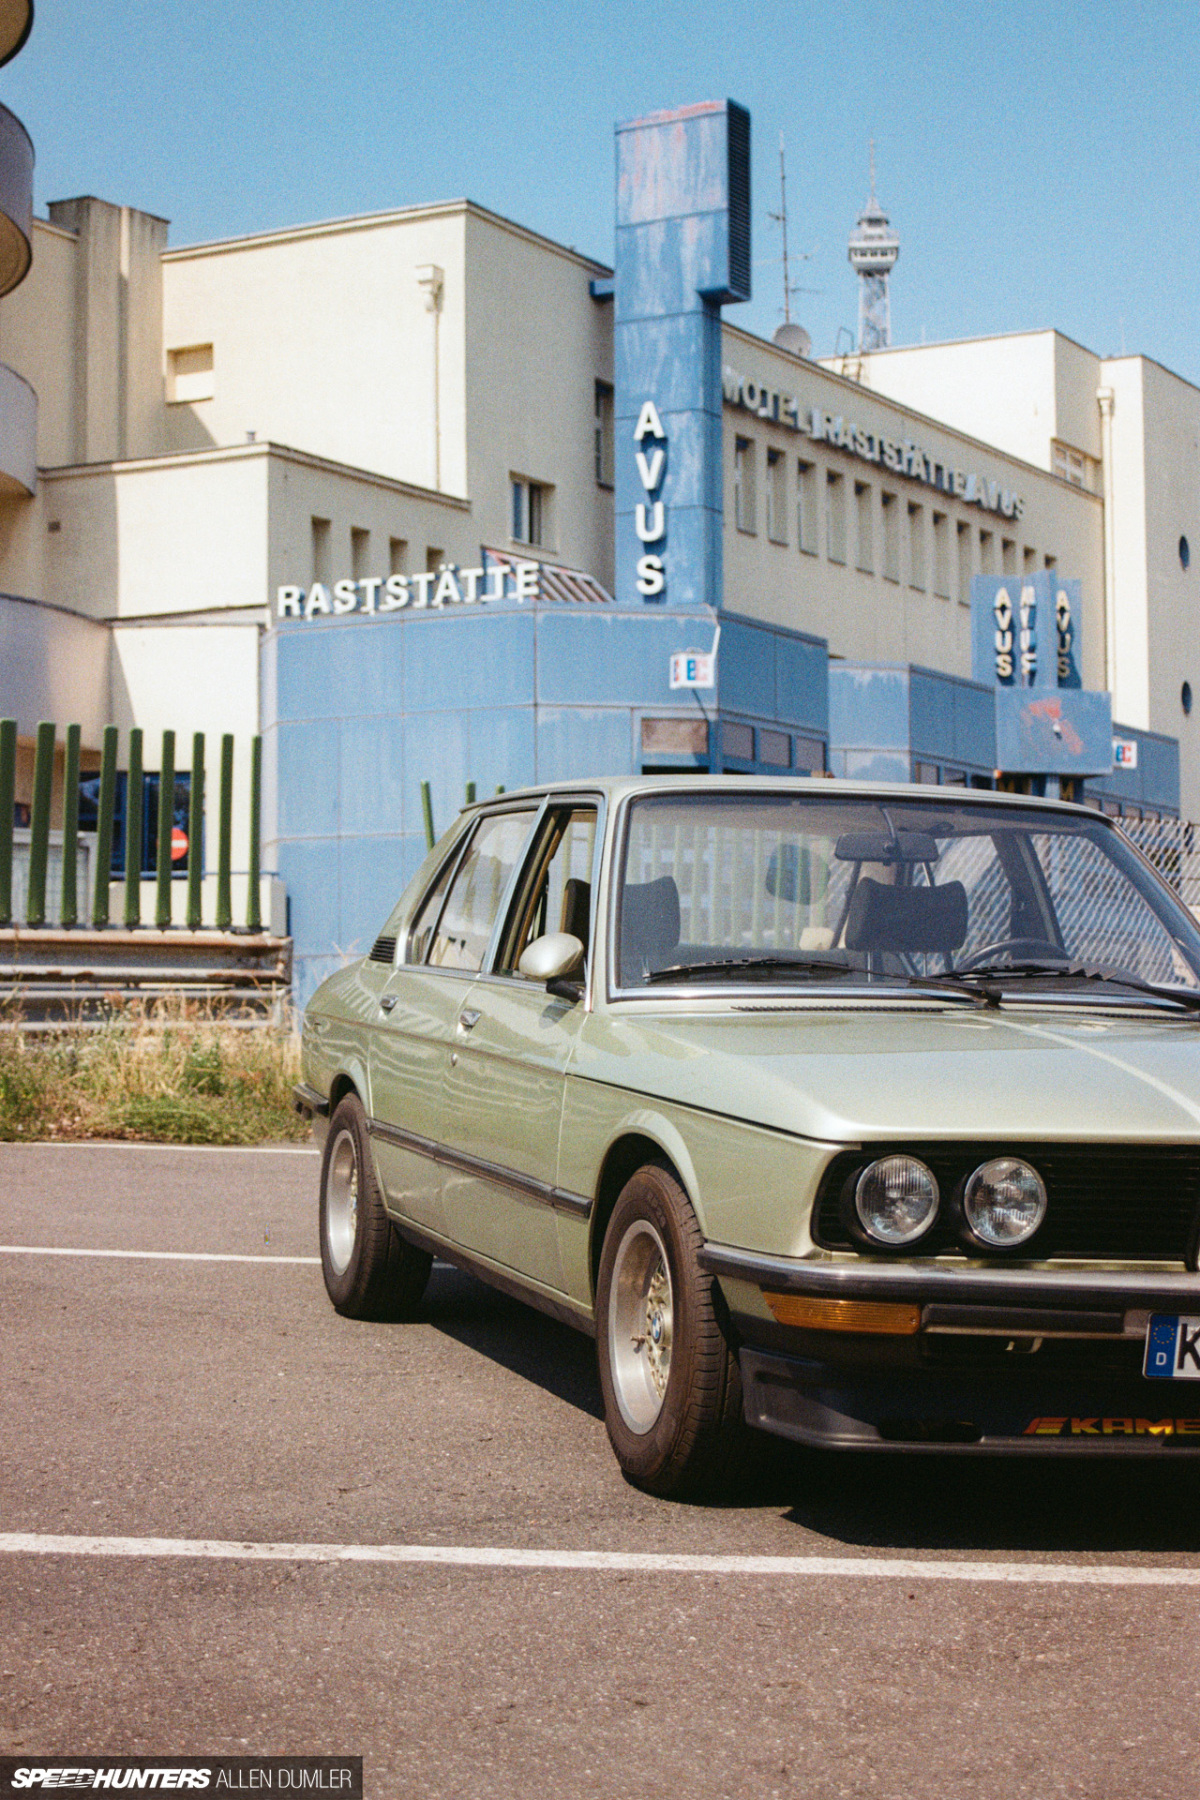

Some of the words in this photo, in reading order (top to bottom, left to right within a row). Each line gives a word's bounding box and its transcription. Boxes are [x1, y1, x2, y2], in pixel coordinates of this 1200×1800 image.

[634, 401, 665, 595] AVUS
[813, 409, 966, 499] RASTSTÄTTE
[964, 473, 1025, 520] AVUS
[277, 562, 540, 622] RASTSTÄTTE
[994, 587, 1013, 677] AVUS
[1057, 590, 1071, 677] AVUS
[1155, 1352, 1168, 1366] D
[1177, 1323, 1200, 1370] K
